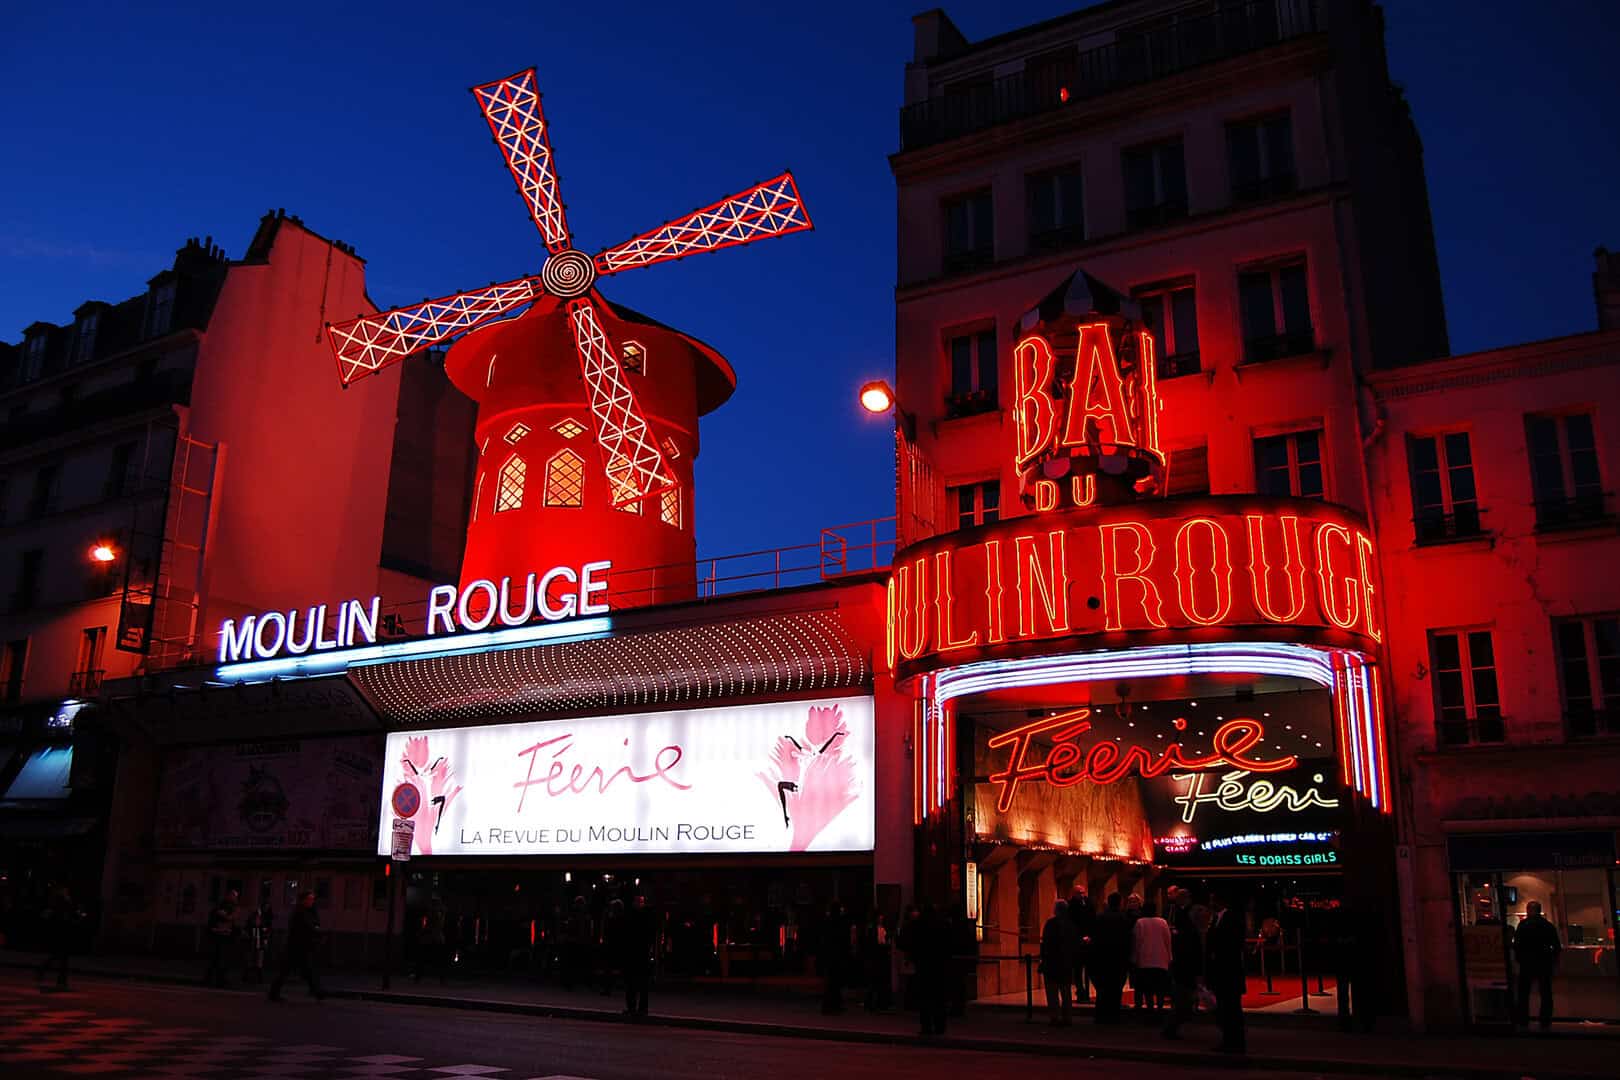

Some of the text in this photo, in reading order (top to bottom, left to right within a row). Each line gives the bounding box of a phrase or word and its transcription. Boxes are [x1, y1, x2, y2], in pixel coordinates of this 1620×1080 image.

[1014, 323, 1166, 477] BAL
[1035, 474, 1094, 512] DU
[218, 561, 612, 663] MOULIN ROUGE
[887, 515, 1382, 670] OULIN ROUGE
[513, 733, 692, 813] Féerie
[988, 709, 1298, 812] Féerie
[1173, 770, 1340, 823] Féeri
[489, 828, 549, 844] REVUE
[588, 825, 669, 843] MOULIN
[676, 823, 755, 841] ROUGE
[1236, 851, 1337, 866] LES DORISS GIRLS
